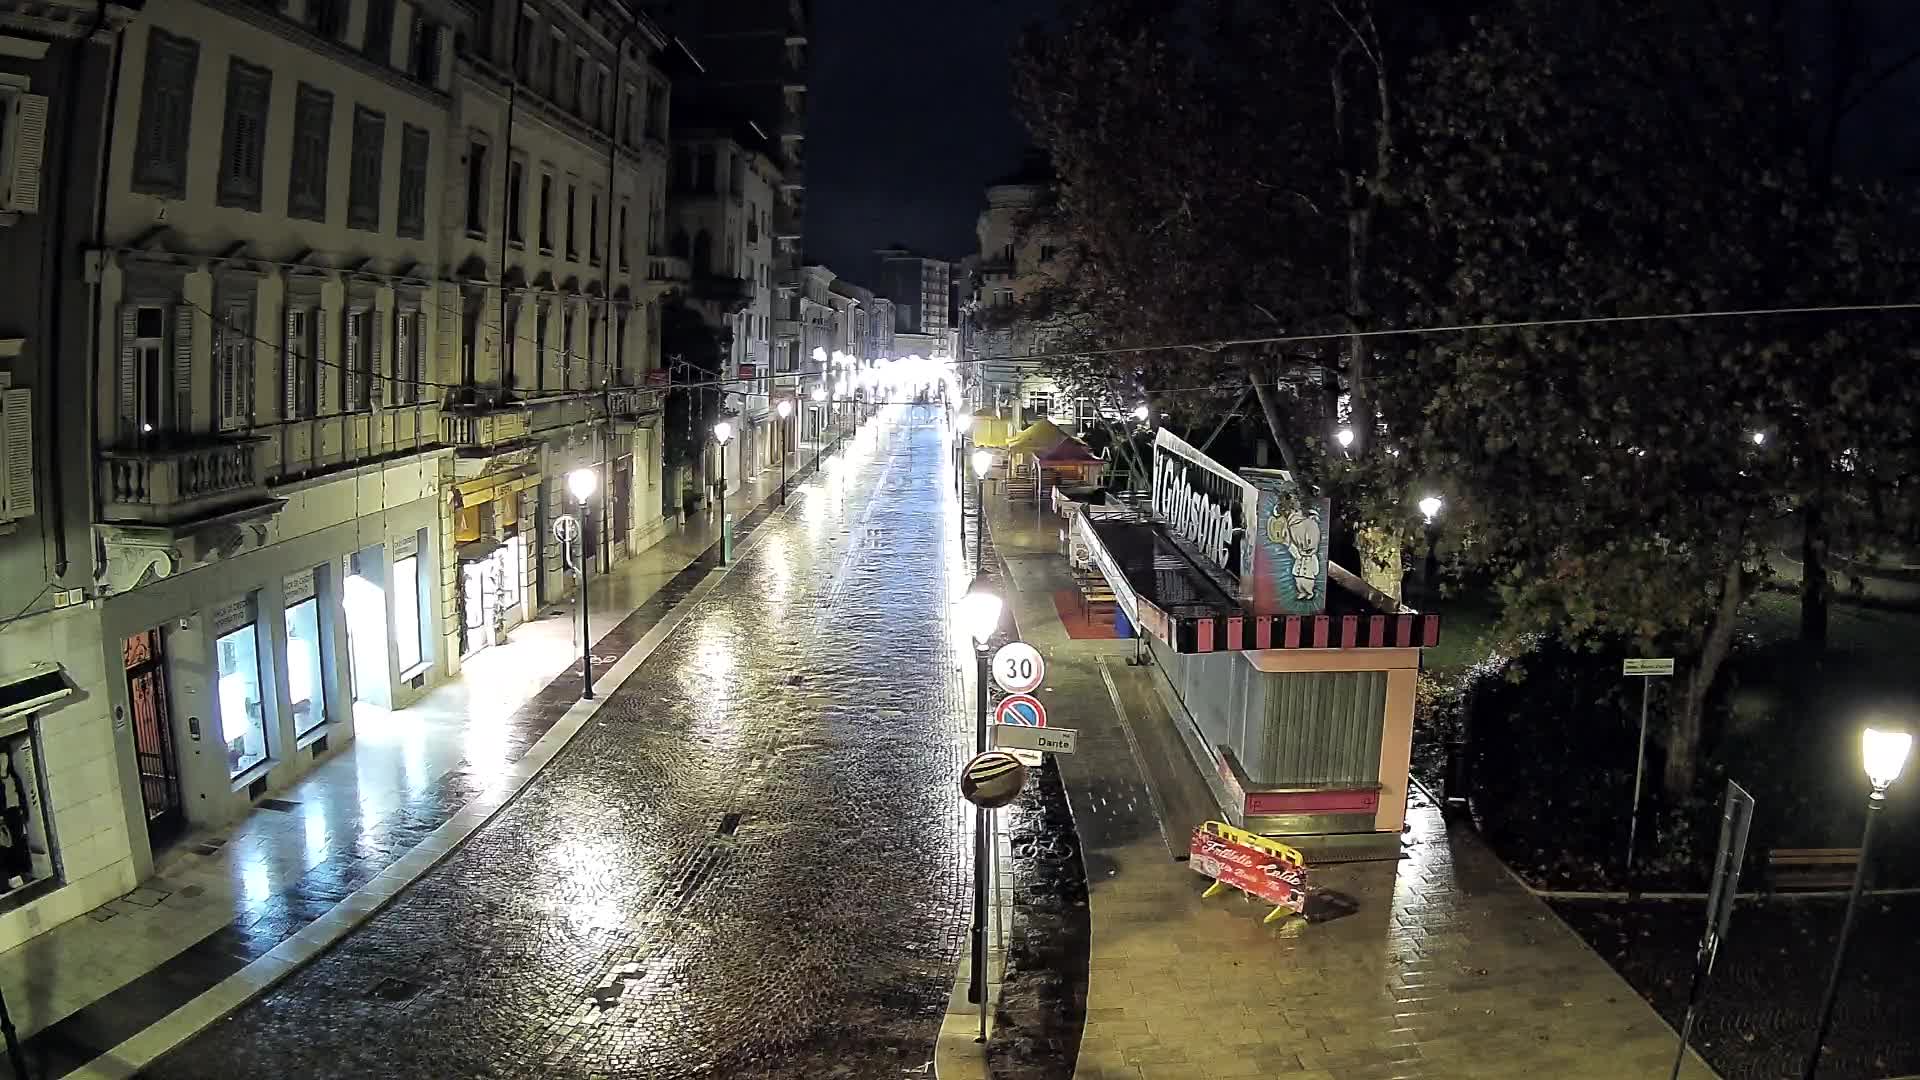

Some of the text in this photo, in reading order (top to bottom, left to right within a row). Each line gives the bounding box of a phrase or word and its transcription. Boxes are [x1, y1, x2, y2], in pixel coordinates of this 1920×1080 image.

[1161, 458, 1233, 569] Golosone
[1006, 658, 1032, 679] 30
[1038, 737, 1070, 749] Dante
[1256, 863, 1301, 886] Calde
